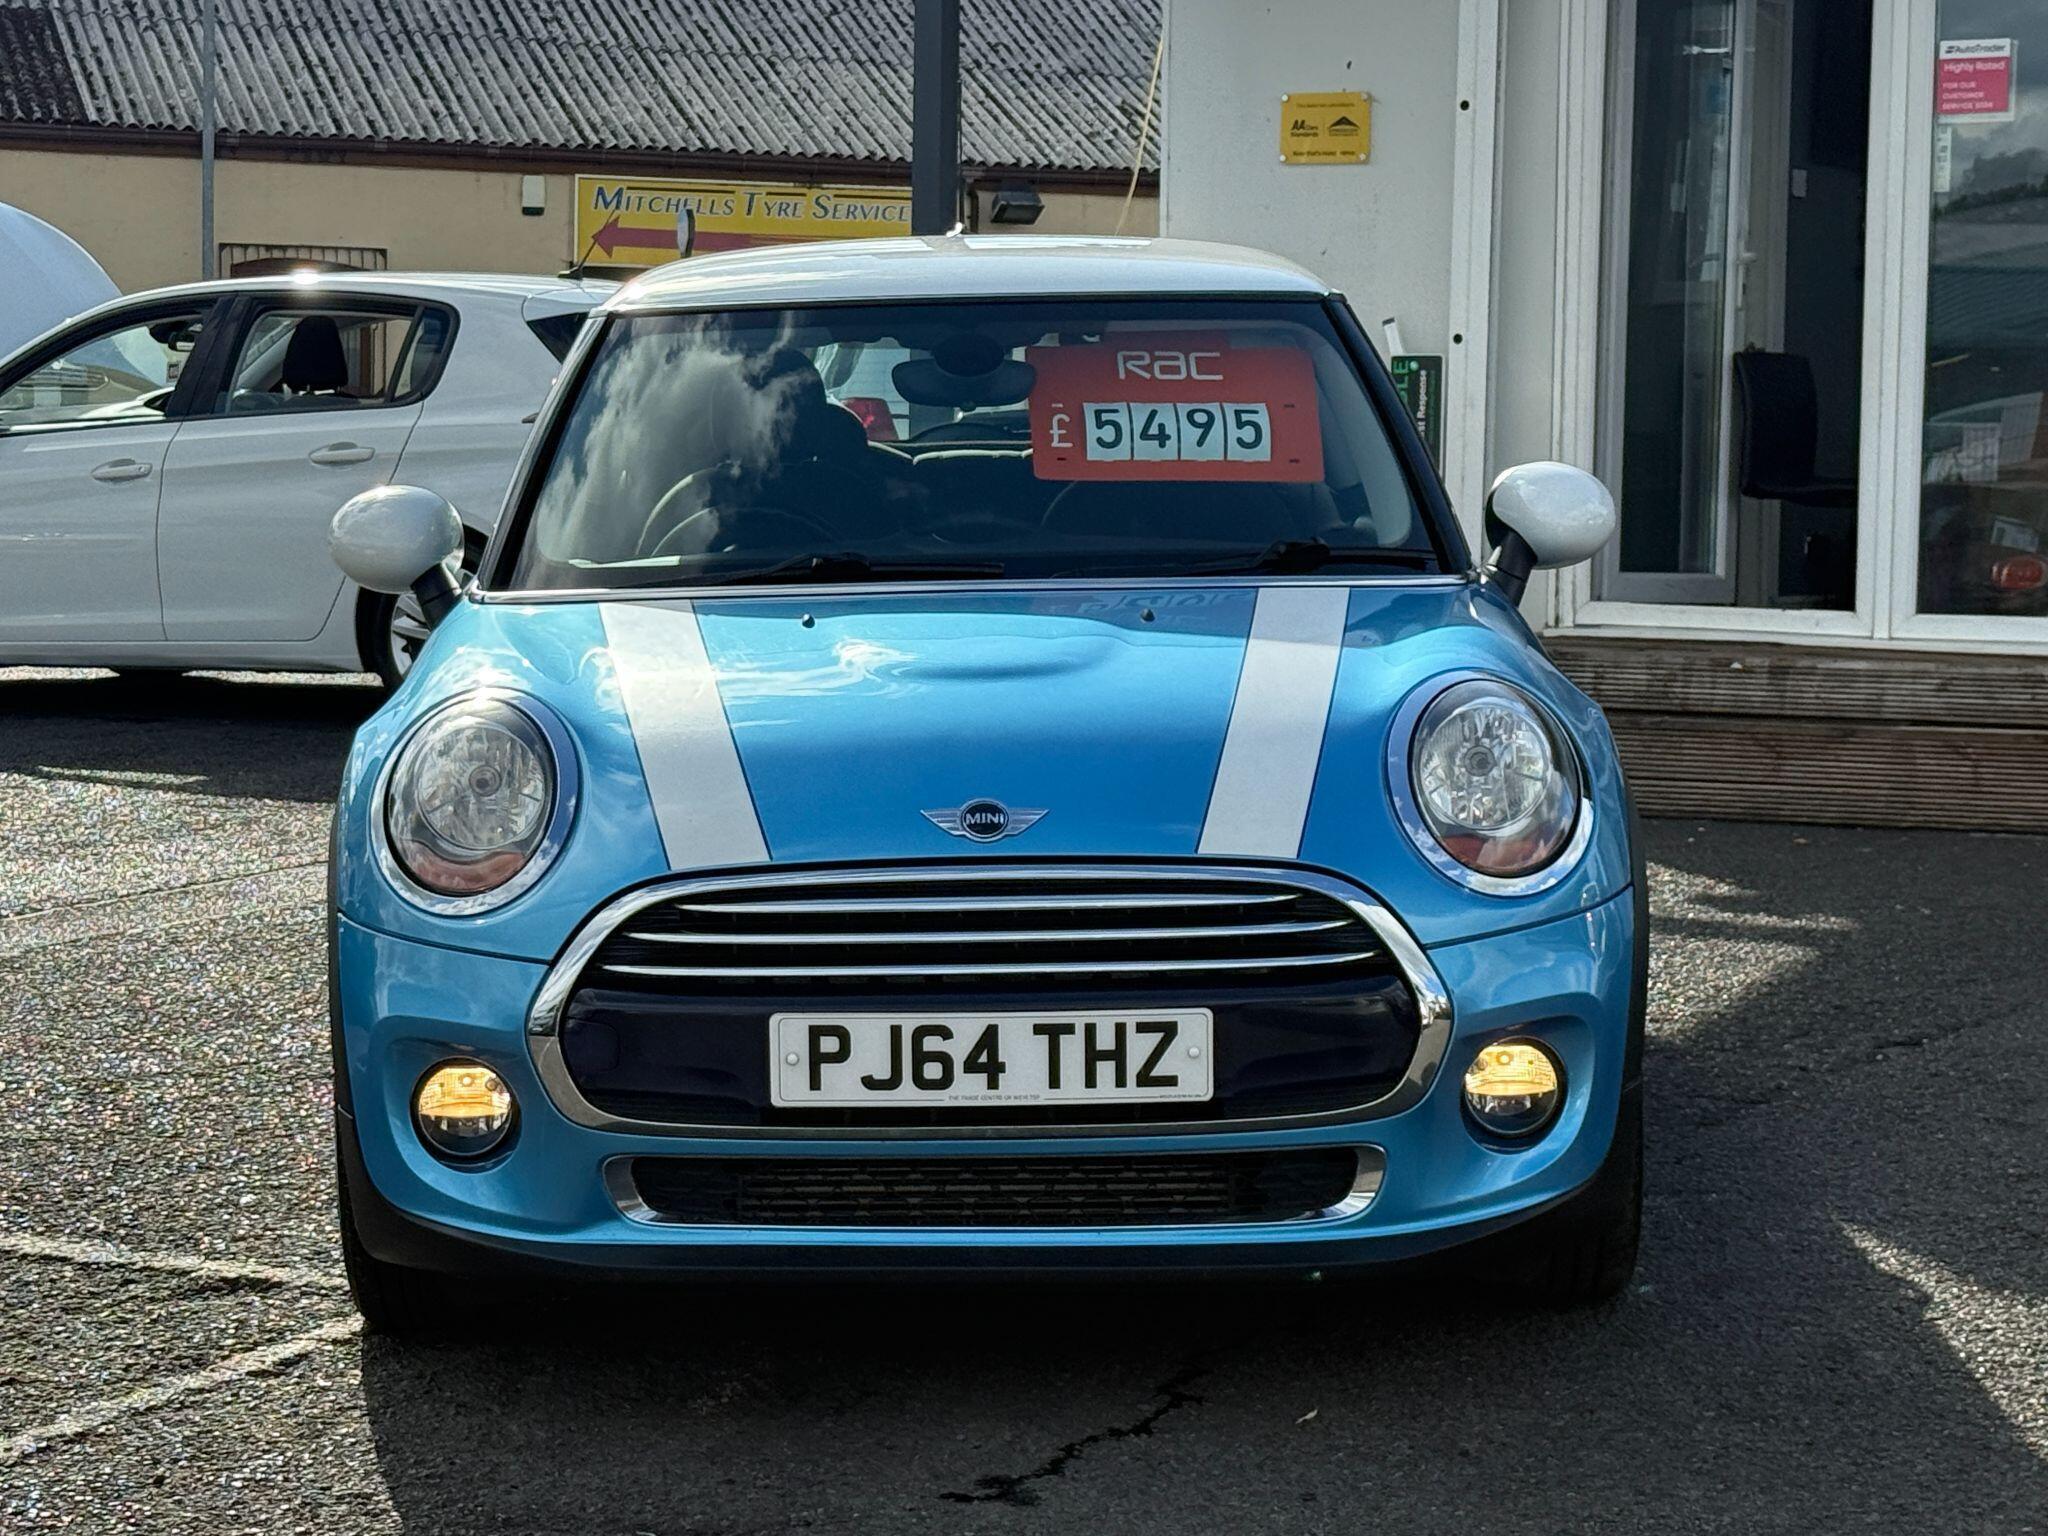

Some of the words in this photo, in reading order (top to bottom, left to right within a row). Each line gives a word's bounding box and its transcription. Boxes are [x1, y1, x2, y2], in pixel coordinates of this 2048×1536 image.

[1943, 62, 1974, 73] Highly
[1976, 61, 2005, 70] Rated
[593, 186, 735, 216] MITCHELLS
[743, 192, 803, 218] TYRE
[812, 194, 910, 222] SERVICE
[1093, 408, 1264, 450] 5495
[965, 813, 1005, 825] MINI
[808, 1024, 1006, 1091] PJ64
[1032, 1021, 1179, 1089] THZ
